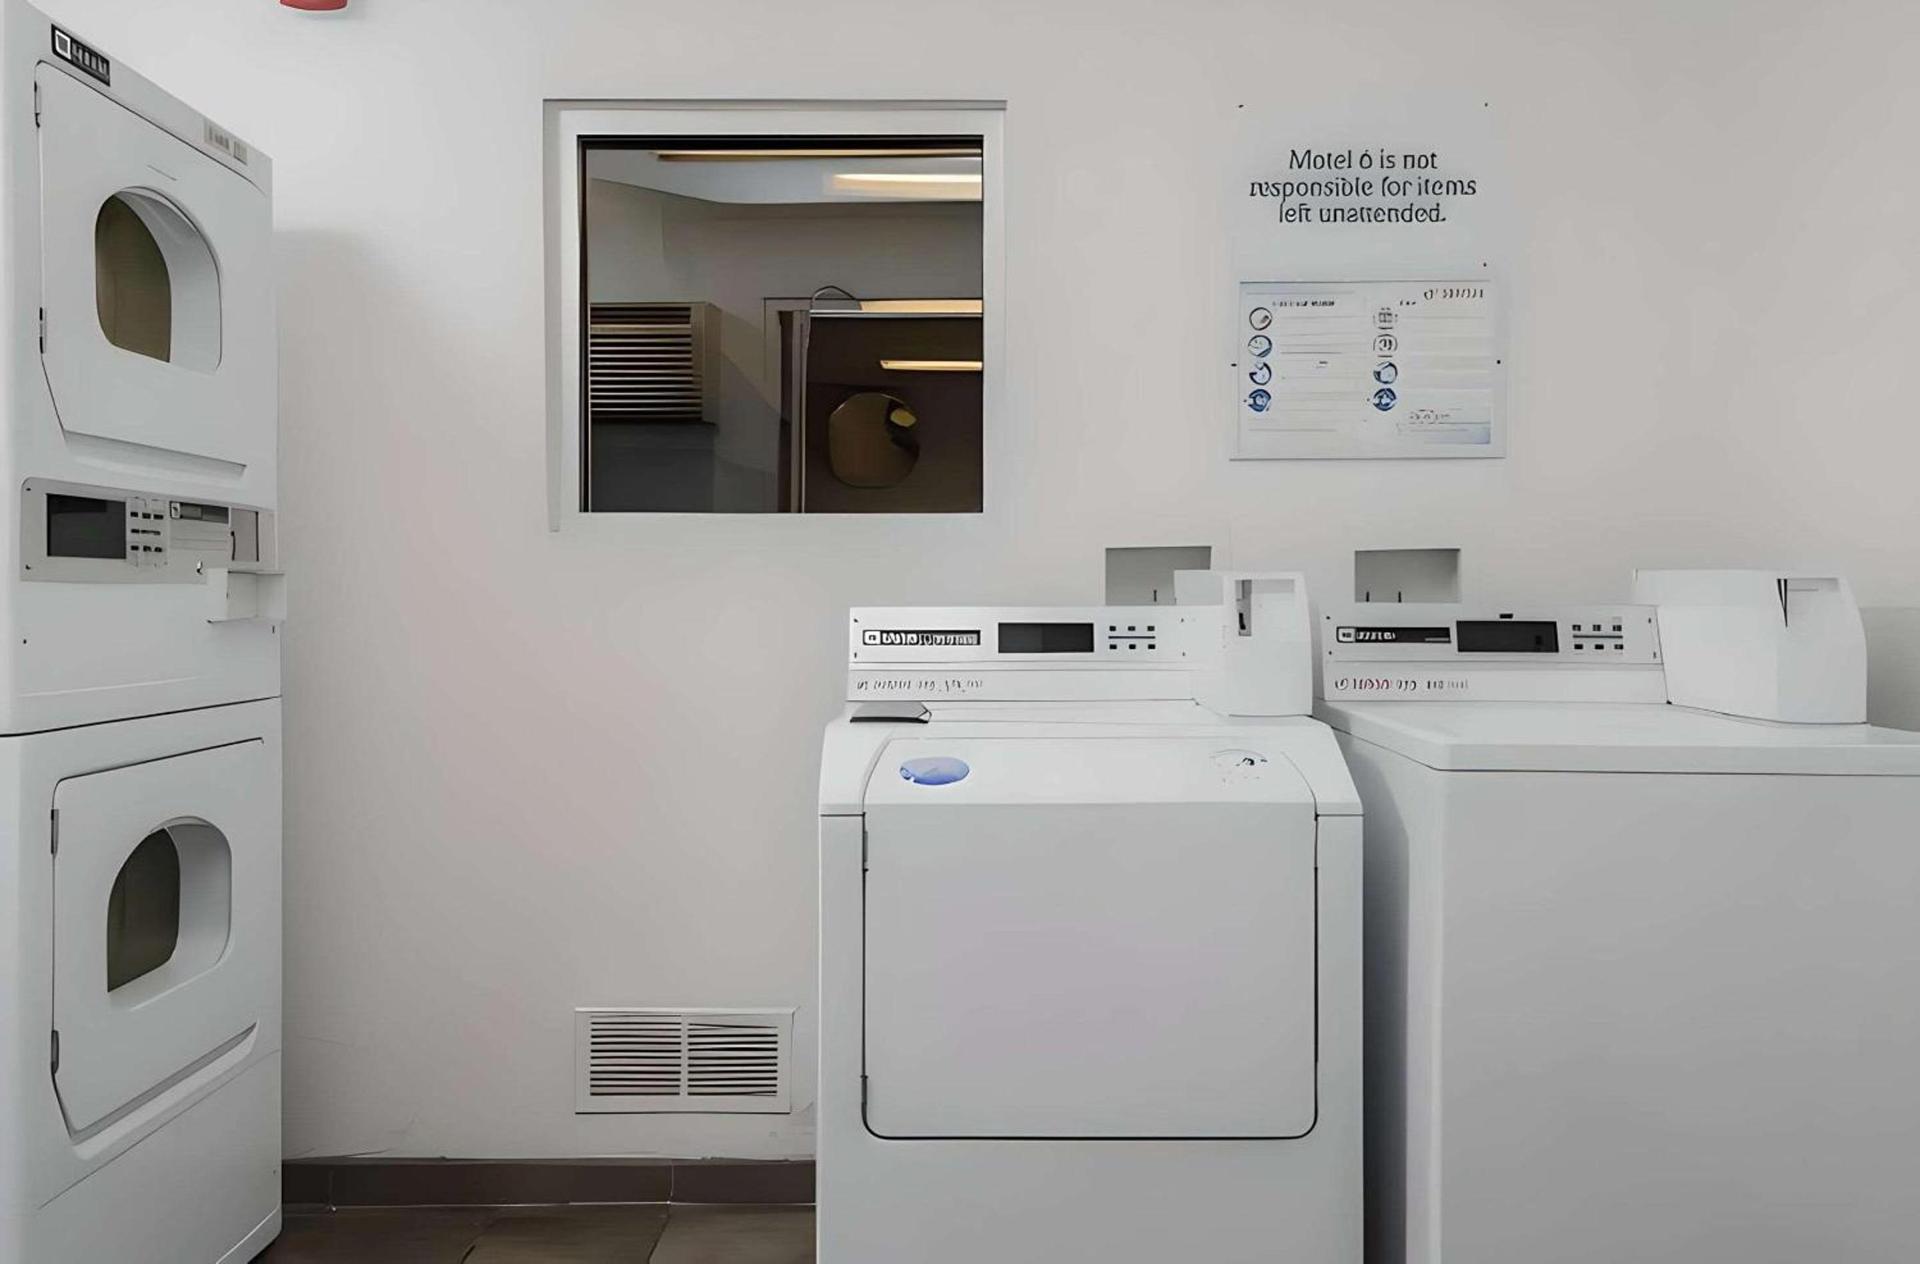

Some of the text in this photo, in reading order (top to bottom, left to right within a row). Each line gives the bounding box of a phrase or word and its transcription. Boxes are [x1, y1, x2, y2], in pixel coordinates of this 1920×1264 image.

[1289, 149, 1353, 170] Motel
[1380, 148, 1396, 169] is
[1403, 152, 1438, 170] not
[1249, 175, 1477, 202] responsible for items
[1279, 201, 1312, 223] left
